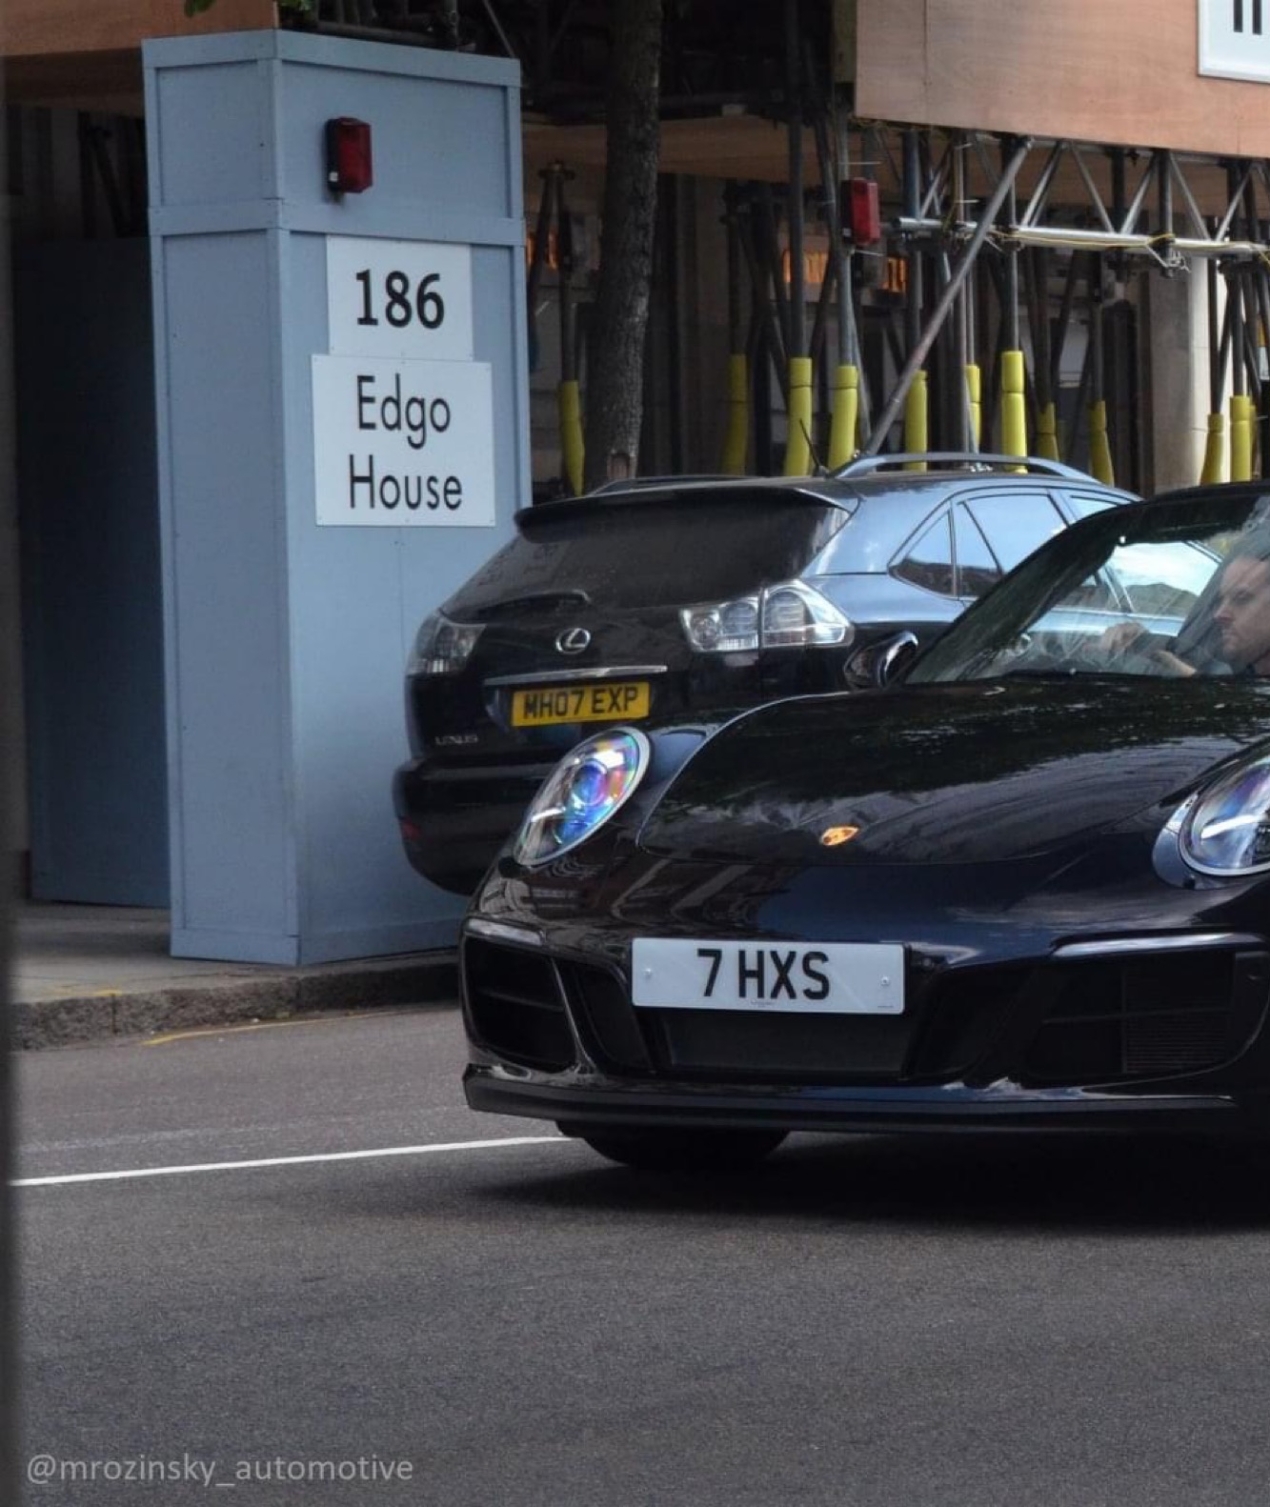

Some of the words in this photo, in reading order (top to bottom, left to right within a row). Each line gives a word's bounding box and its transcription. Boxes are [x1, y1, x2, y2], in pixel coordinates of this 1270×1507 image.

[355, 268, 445, 330] 186
[356, 373, 451, 450] Edgo
[348, 454, 463, 511] House
[523, 690, 586, 720] MH07
[591, 686, 639, 715] EXP
[697, 948, 723, 998] 7
[738, 949, 830, 1001] HXS
